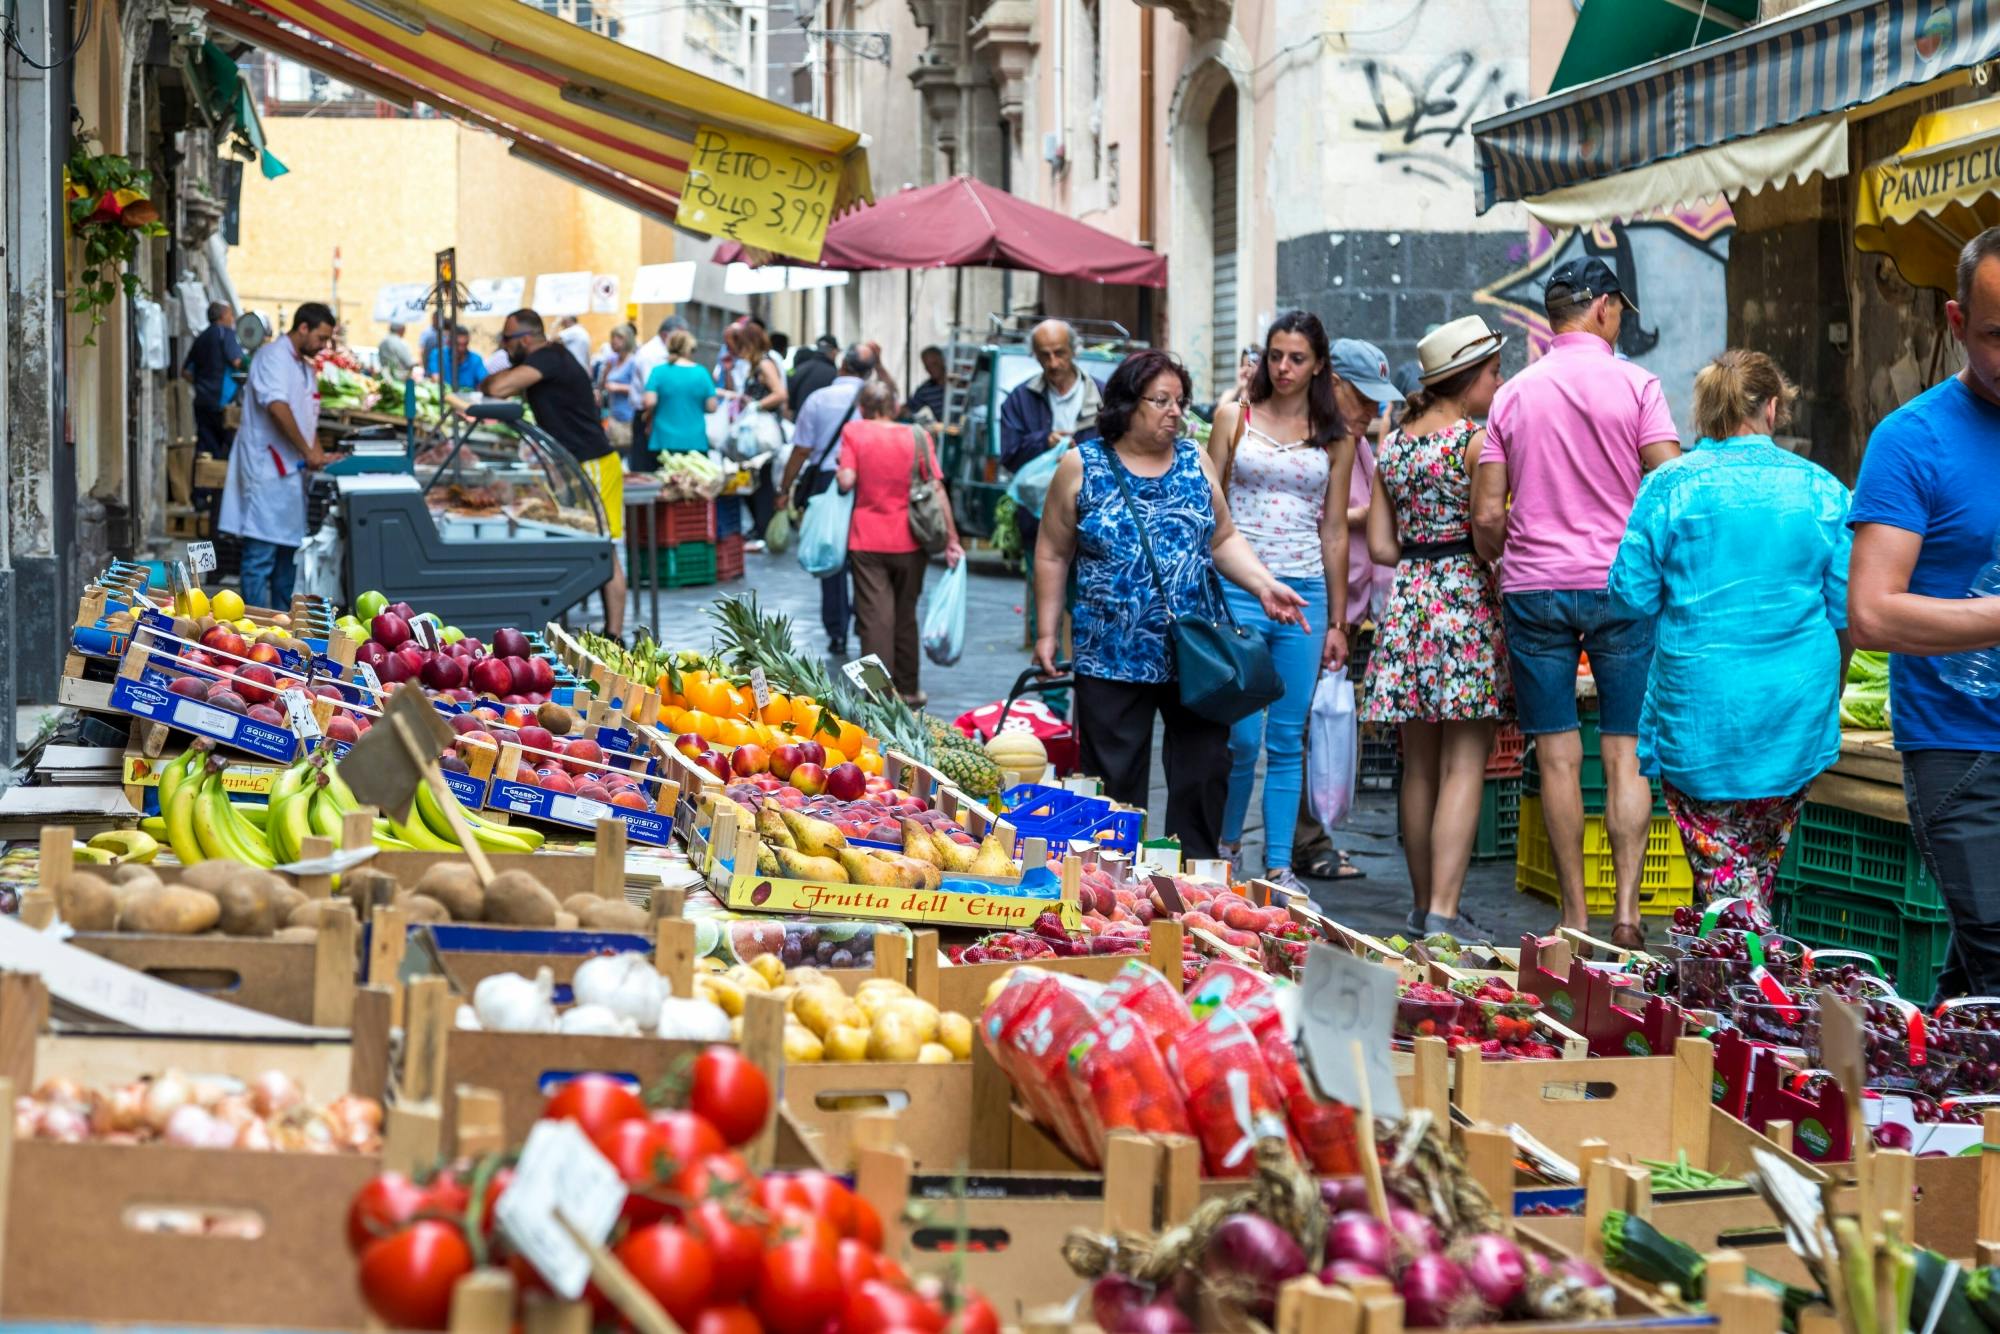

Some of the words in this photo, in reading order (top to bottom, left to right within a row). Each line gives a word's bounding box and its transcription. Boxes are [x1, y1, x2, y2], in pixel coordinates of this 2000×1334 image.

[683, 169, 758, 219] POLLO
[764, 191, 826, 241] 3,99
[132, 688, 162, 702] GRASSO
[246, 726, 286, 744] SQUISITA
[509, 788, 538, 801] GRASSO
[793, 885, 890, 910] Frutta
[900, 893, 947, 914] dell
